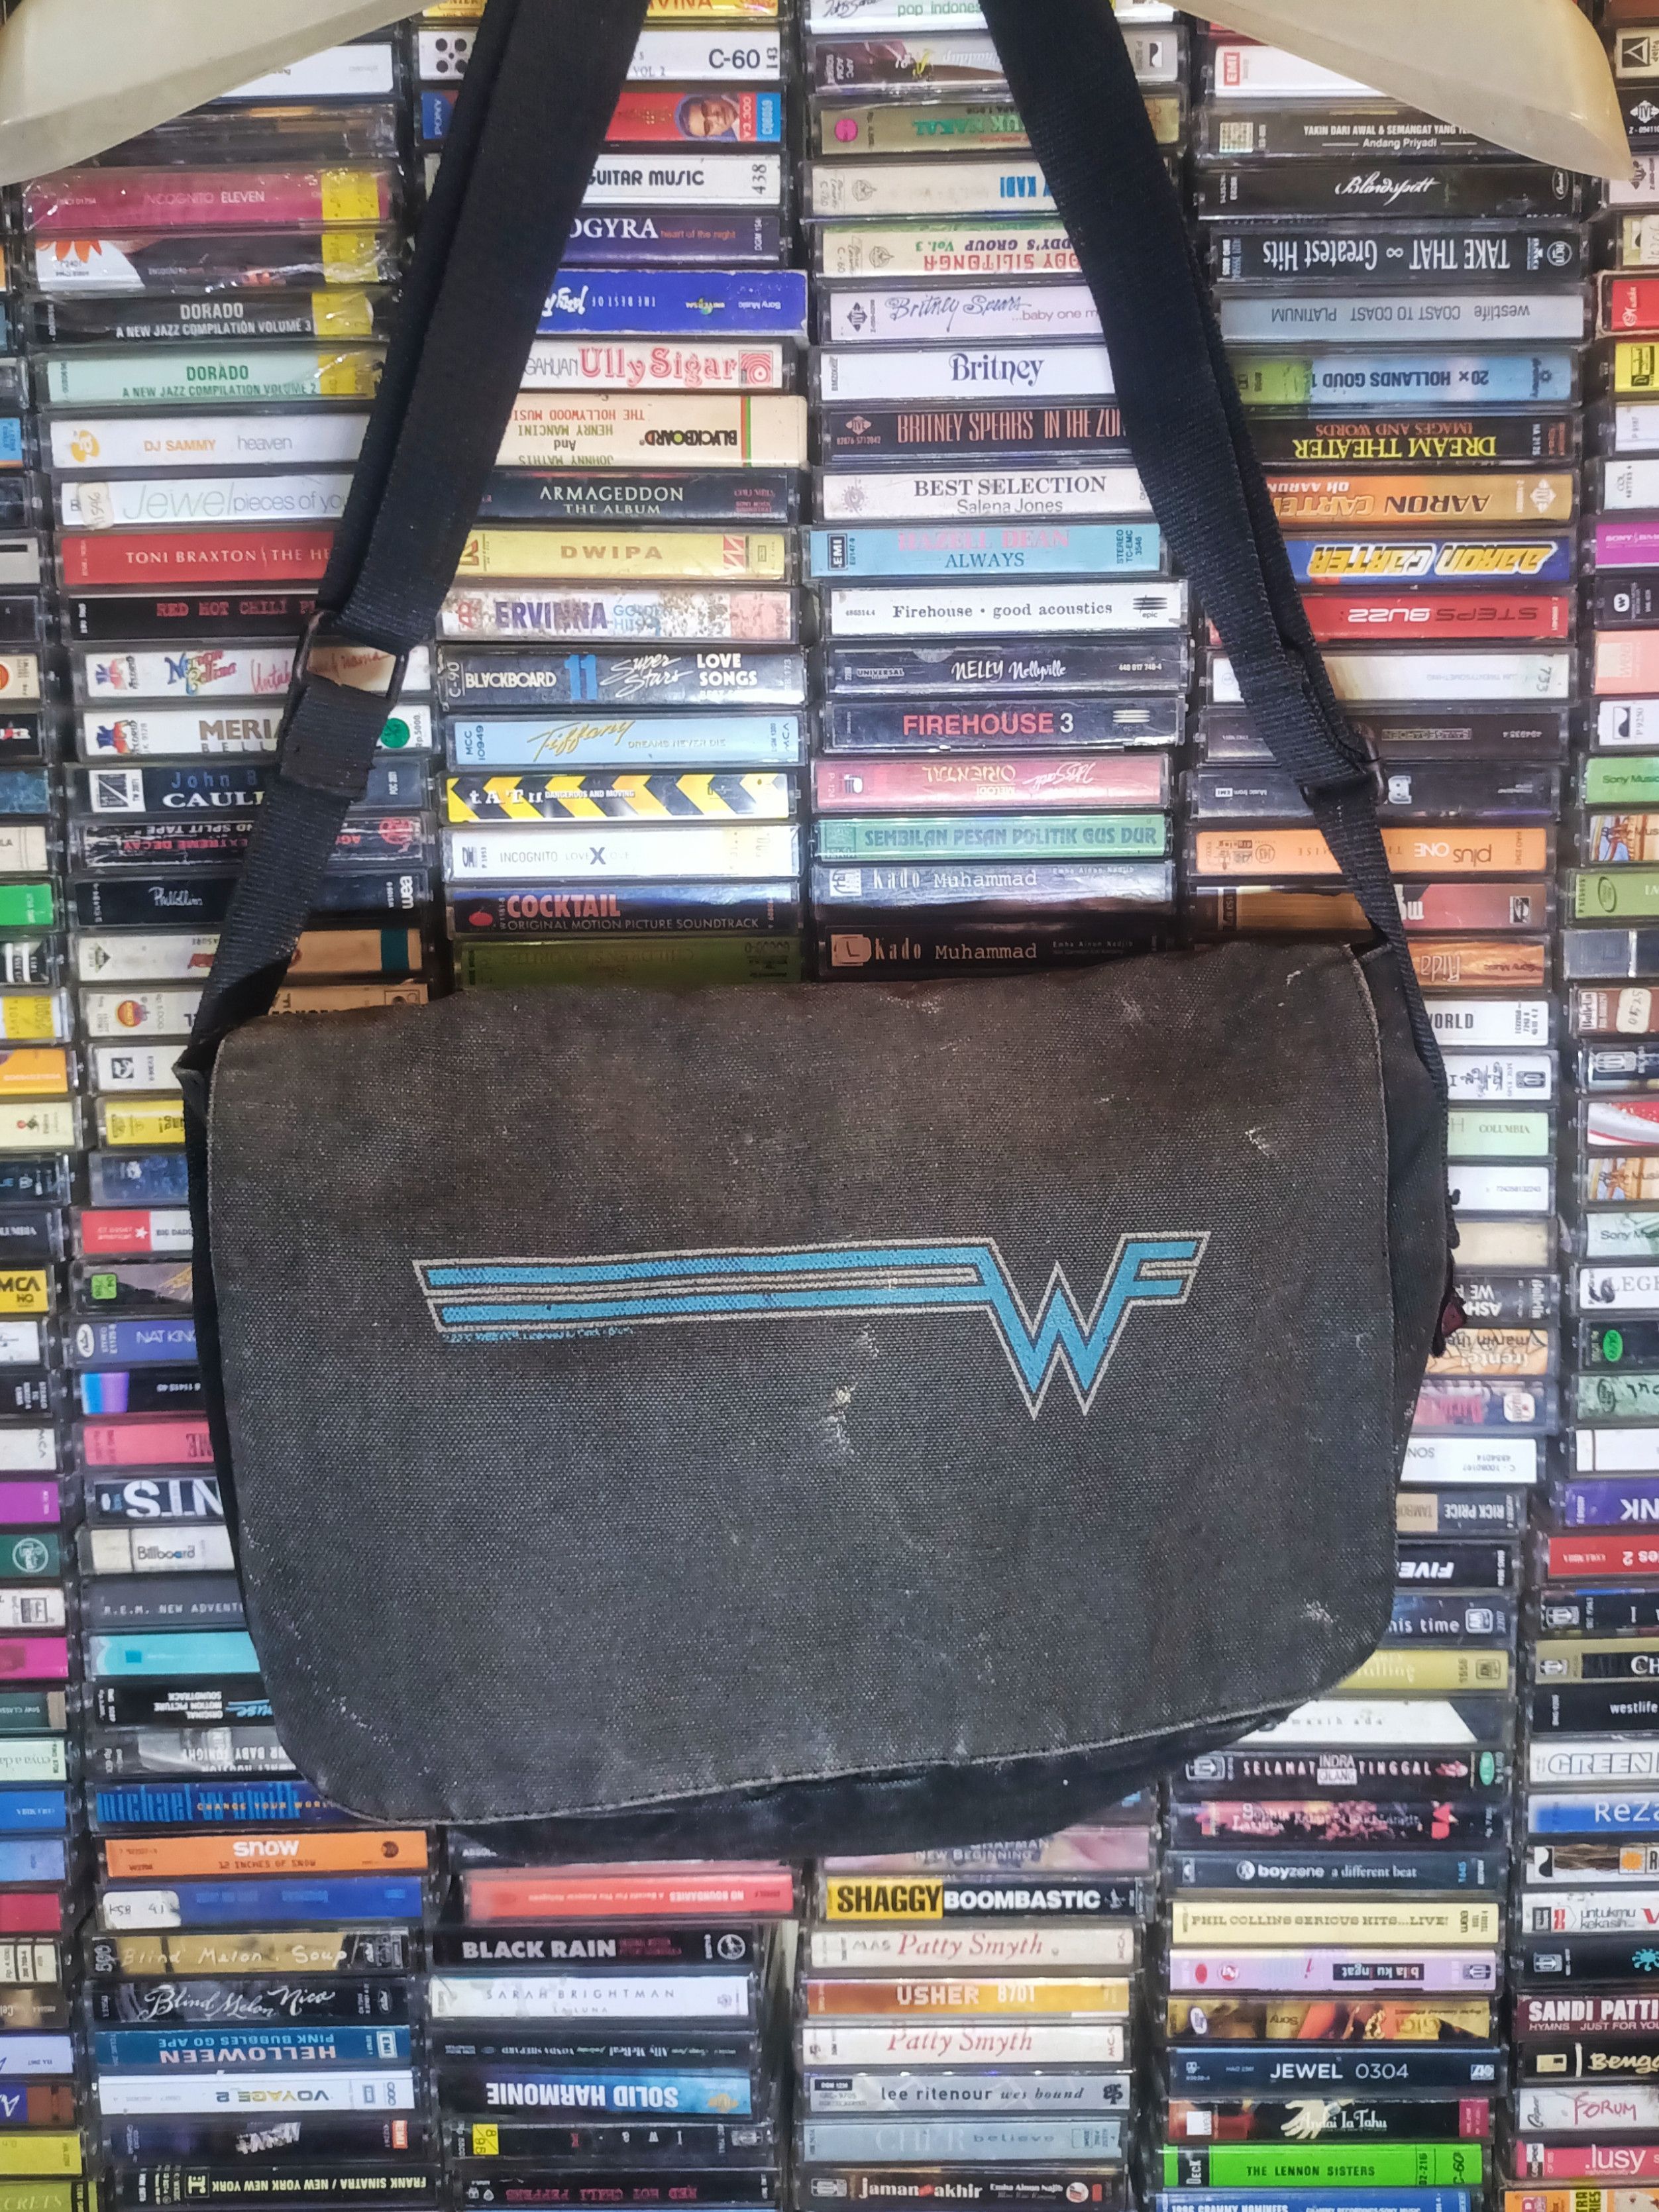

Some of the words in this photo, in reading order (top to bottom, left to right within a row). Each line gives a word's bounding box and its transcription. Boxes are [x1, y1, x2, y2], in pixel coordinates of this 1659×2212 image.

[898, 4, 923, 17] pop
[709, 49, 760, 69] C-60
[1226, 56, 1238, 83] EMI
[1379, 125, 1384, 135] &
[1362, 138, 1400, 150] Andang
[1403, 138, 1436, 150] Priyadi
[649, 171, 704, 185] MUSIC
[752, 164, 767, 194] 438
[221, 191, 264, 203] ELEVEN
[965, 240, 1017, 252] GROUP
[1263, 240, 1298, 270] Hits
[1305, 240, 1377, 271] Greatest
[1410, 239, 1457, 270] THAT
[1464, 238, 1510, 270] TAKE
[924, 254, 1034, 271] SILITONGA
[180, 303, 243, 319] DORADO
[1271, 307, 1337, 322] PLATINUM
[1351, 307, 1391, 321] COAST
[1418, 306, 1460, 321] COAST
[1474, 305, 1530, 319] westlife
[183, 323, 255, 335] COMPILATION
[187, 366, 249, 381] DORADO
[949, 354, 1044, 386] Britney
[1323, 373, 1365, 388] GOUD
[1371, 372, 1450, 387] HOLLANDS
[549, 409, 616, 420] HOLLYWOOD
[623, 409, 645, 420] THE
[518, 425, 569, 435] MANCINI
[576, 425, 613, 435] HENRY
[898, 413, 963, 443] BRITNEY
[969, 411, 1034, 441] SPEARS
[1316, 425, 1371, 437] WORDS
[1376, 424, 1409, 436] AND
[1417, 423, 1473, 435] IMAGES
[144, 440, 162, 451] DJ
[166, 439, 215, 451] SAMMY
[238, 435, 292, 450] heaven
[554, 439, 576, 450] And
[1295, 439, 1401, 459] THEATER
[1409, 437, 1496, 456] DREAM
[540, 486, 684, 501] ARMAGEDDON
[914, 480, 972, 496] BEST
[978, 476, 1106, 494] SELECTION
[564, 504, 598, 513] THE
[604, 504, 660, 514] ALBUM
[957, 498, 1010, 513] Salena
[1015, 498, 1063, 513] Jones
[1002, 530, 1070, 549] DEAN
[126, 551, 168, 564] TONI
[176, 549, 256, 563] BRAXTON
[272, 549, 302, 560] THE
[561, 545, 662, 559] DWIPA
[830, 537, 843, 567] EMI
[945, 553, 1024, 568] ALWAYS
[156, 603, 189, 616] RED
[893, 606, 973, 618] Firehouse
[993, 604, 1031, 619] good
[1039, 603, 1112, 615] acoustics
[697, 654, 741, 668] LOVE
[449, 662, 460, 698] C-90
[700, 671, 757, 686] SONGS
[903, 713, 1054, 735] FIREHOUSE
[1061, 713, 1073, 733] 3
[527, 721, 635, 761] Tiffany
[171, 771, 231, 790] John
[922, 766, 1016, 784] ORIENTAL
[1602, 775, 1631, 784] Sony
[865, 829, 947, 846] SEMBILAN
[954, 828, 1007, 845] PESAN
[1012, 828, 1077, 845] POLITIK
[1083, 828, 1115, 844] GUS
[1121, 827, 1157, 844] DUR
[123, 841, 172, 851] DECAY
[1414, 843, 1449, 858] ONE
[500, 852, 558, 863] INCOGNITO
[1453, 844, 1491, 867] plus
[934, 870, 1038, 888] Muhammad
[507, 895, 621, 918] COCKTAIL
[508, 919, 568, 931] ORIGINAL
[572, 919, 621, 930] MOTION
[625, 919, 671, 930] PICTURE
[676, 918, 759, 929] SOUNDTRACK
[936, 943, 1038, 960] Muhammad
[1479, 1124, 1530, 1133] COLUMBIA
[1601, 1230, 1629, 1241] Sony
[136, 1330, 165, 1343] NAT
[1444, 1504, 1475, 1518] PRICE
[1478, 1506, 1504, 1519] RICK
[137, 1546, 195, 1559] Billboard
[1420, 1617, 1459, 1634] time
[1610, 1701, 1657, 1714] westlife
[233, 1747, 265, 1761] BABY
[1244, 1761, 1315, 1776] SELAMAT
[1359, 1761, 1432, 1776] TINGGAL
[1548, 1751, 1652, 1774] GREEN
[233, 1840, 299, 1857] snow
[1258, 1864, 1324, 1879] boyzone
[1340, 1865, 1390, 1878] different
[837, 1885, 942, 1913] SHAGGY
[944, 1889, 1101, 1909] BOOMBASTIC
[1192, 1916, 1226, 1926] PHIL
[1230, 1916, 1292, 1926] COLLINS
[1295, 1916, 1359, 1926] SERIOUS
[463, 1940, 545, 1960] BLACK
[551, 1940, 616, 1958] RAIN
[897, 1931, 962, 1958] Patty
[969, 1932, 1042, 1958] Smyth
[292, 1944, 348, 1967] Soup
[487, 1988, 547, 2000] SARAH
[559, 1988, 674, 1999] BRIGHTMAN
[896, 1987, 979, 2005] USHER
[1528, 2000, 1593, 2021] SANDI
[1530, 2022, 1570, 2030] HYMNS
[1580, 2022, 1609, 2030] JUST
[220, 2035, 288, 2045] BUBBLES
[296, 2034, 334, 2043] PINK
[382, 2034, 396, 2055] EMI
[160, 2046, 336, 2064] HELLOWEEN
[1270, 2063, 1343, 2080] JEWEL
[1355, 2063, 1409, 2079] 0304
[238, 2090, 329, 2102] VOYAGE
[487, 2082, 605, 2106] HARMONIE
[614, 2085, 678, 2108] SOLID
[881, 2088, 908, 2101] lee
[916, 2087, 993, 2101] ritenour
[1001, 2089, 1027, 2099] wes
[1034, 2087, 1084, 2099] bound
[1574, 2091, 1636, 2125] FORUM
[973, 2133, 1054, 2142] believe
[1246, 2166, 1267, 2176] THE
[1275, 2166, 1319, 2176] LENNON
[1327, 2166, 1375, 2176] SISTERS
[1453, 2152, 1465, 2184] C-60
[340, 2178, 387, 2189] SINATRA
[390, 2177, 426, 2189] FRANK
